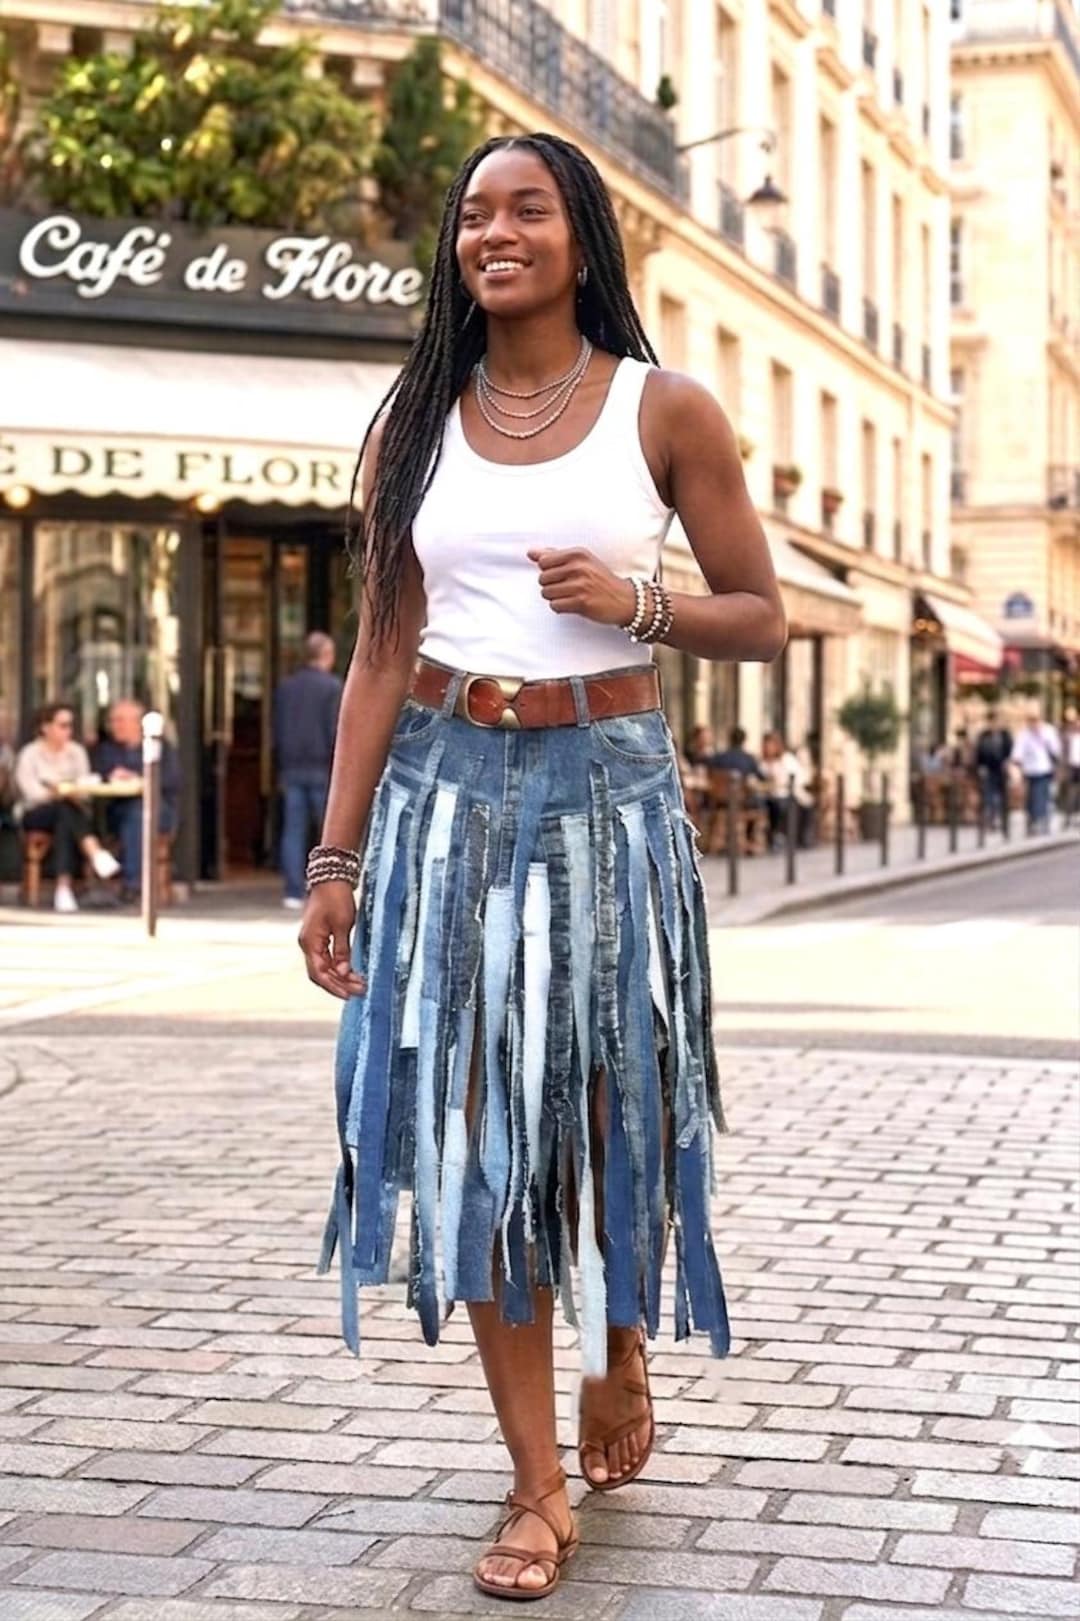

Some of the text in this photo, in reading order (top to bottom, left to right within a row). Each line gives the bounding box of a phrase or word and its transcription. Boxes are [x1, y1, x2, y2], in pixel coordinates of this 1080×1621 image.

[20, 214, 423, 306] Café de Flore
[52, 445, 143, 479] DE
[176, 452, 358, 490] FLOR
